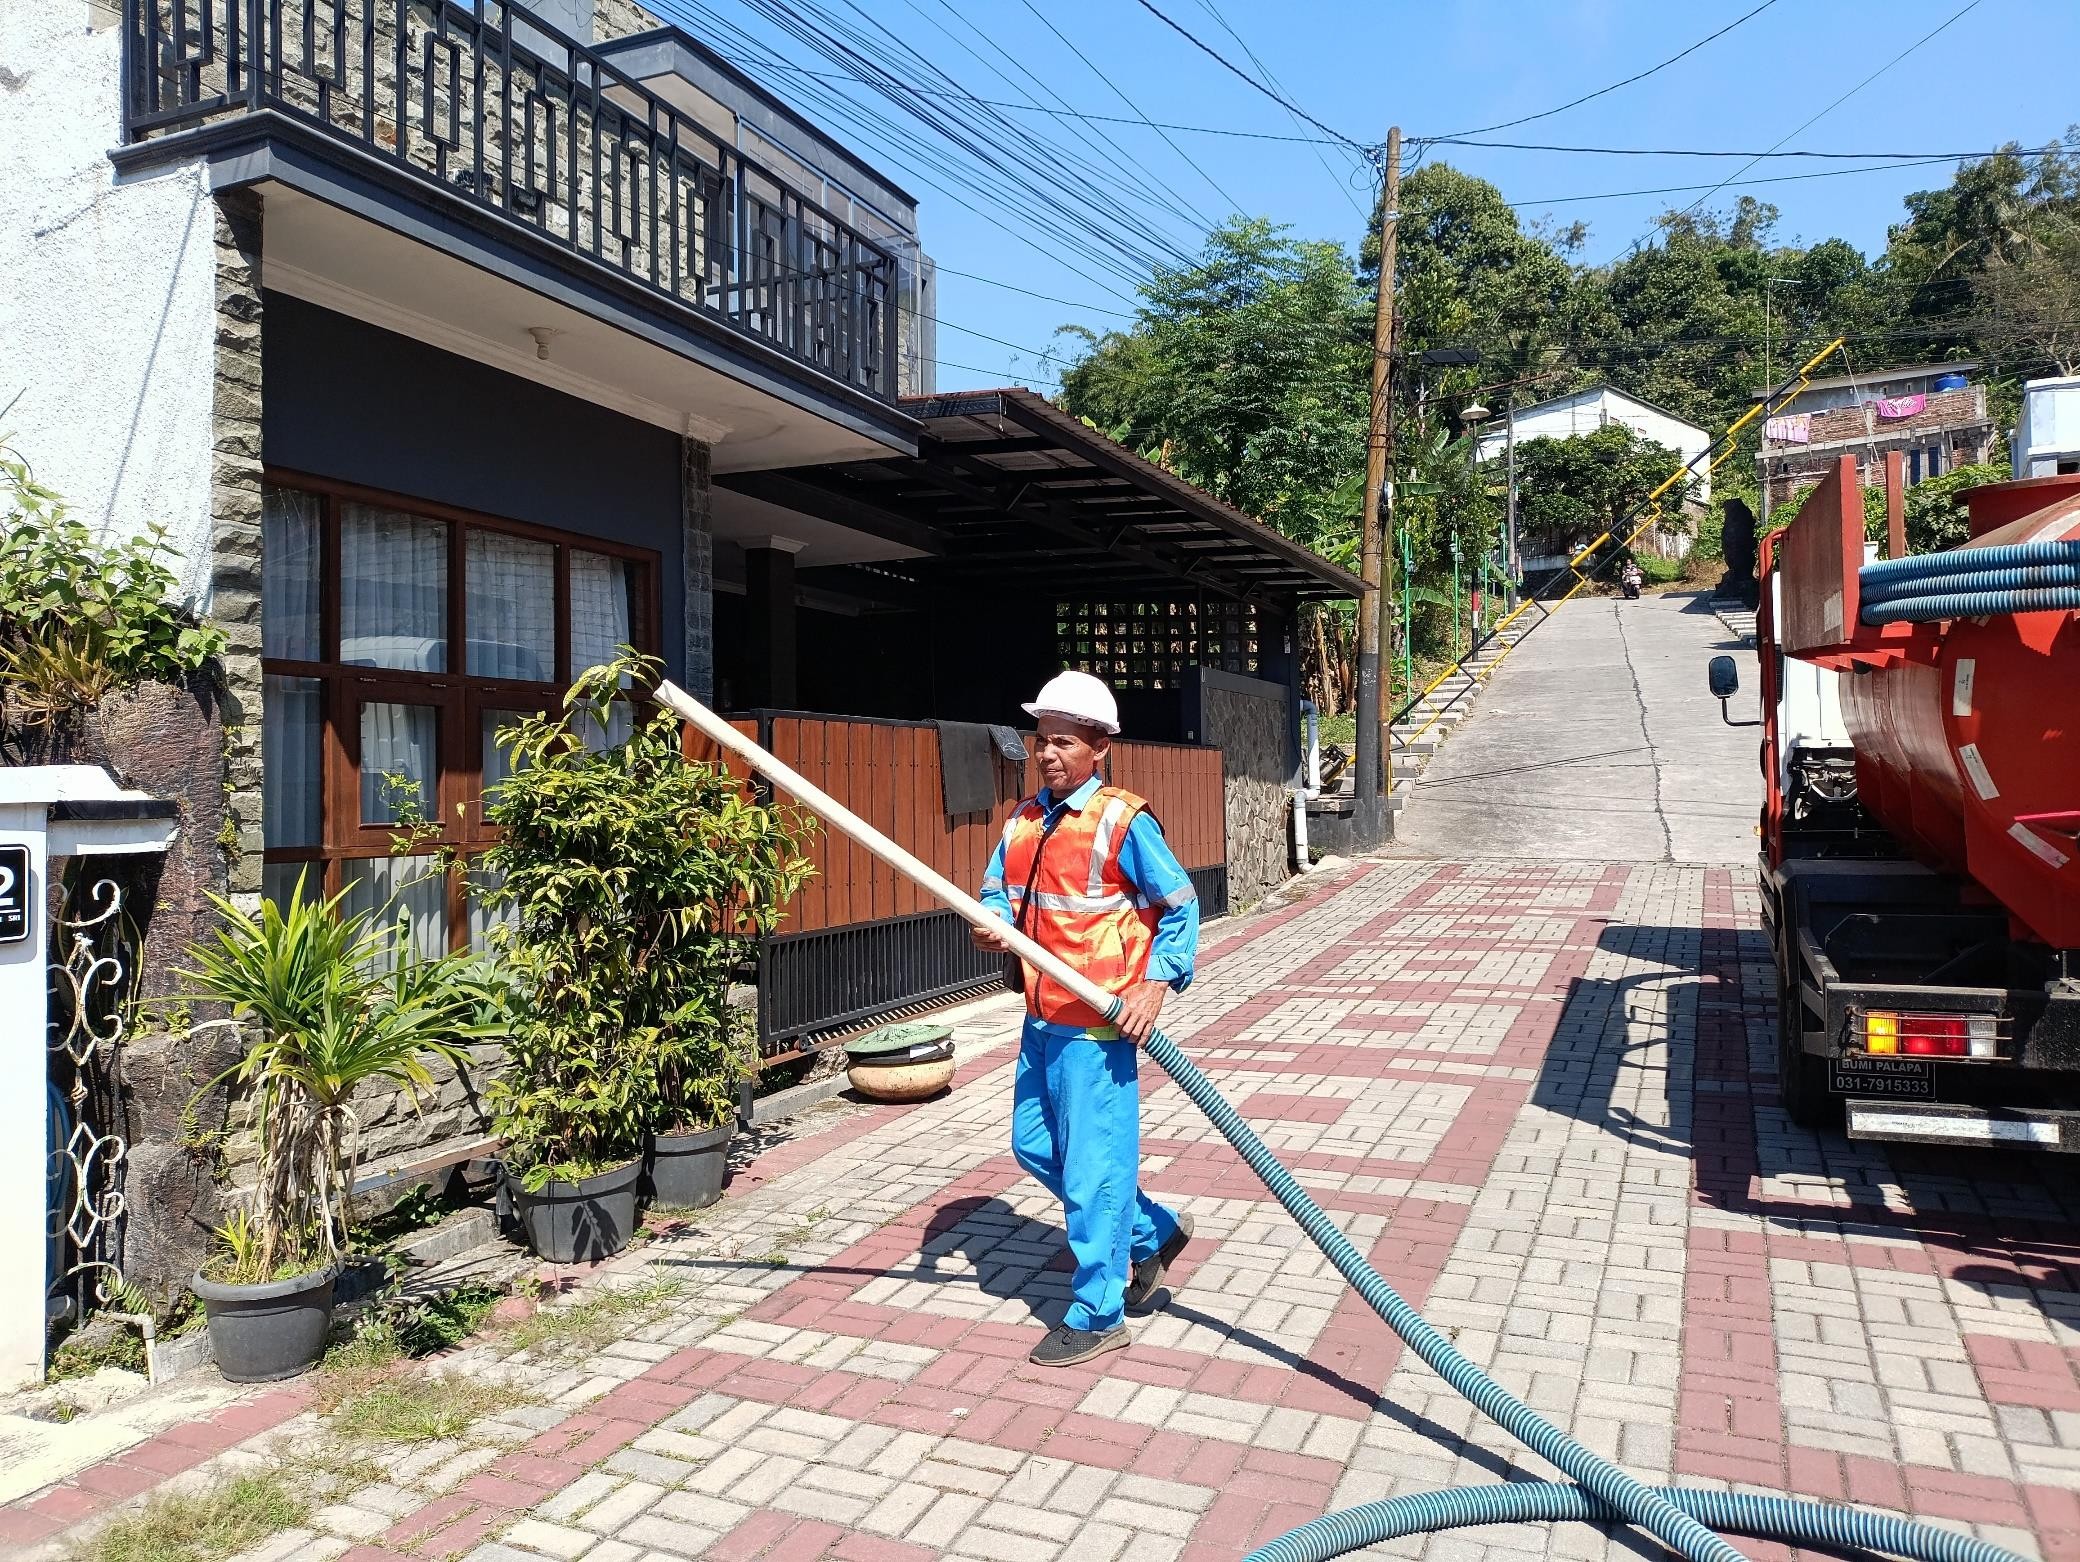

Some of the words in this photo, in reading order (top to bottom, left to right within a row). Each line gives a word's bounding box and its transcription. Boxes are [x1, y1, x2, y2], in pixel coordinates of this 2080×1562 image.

[1841, 1059, 1872, 1070] BUMI
[1876, 1062, 1922, 1073] PALAPA
[1836, 1076, 1929, 1094] 031-7915333
